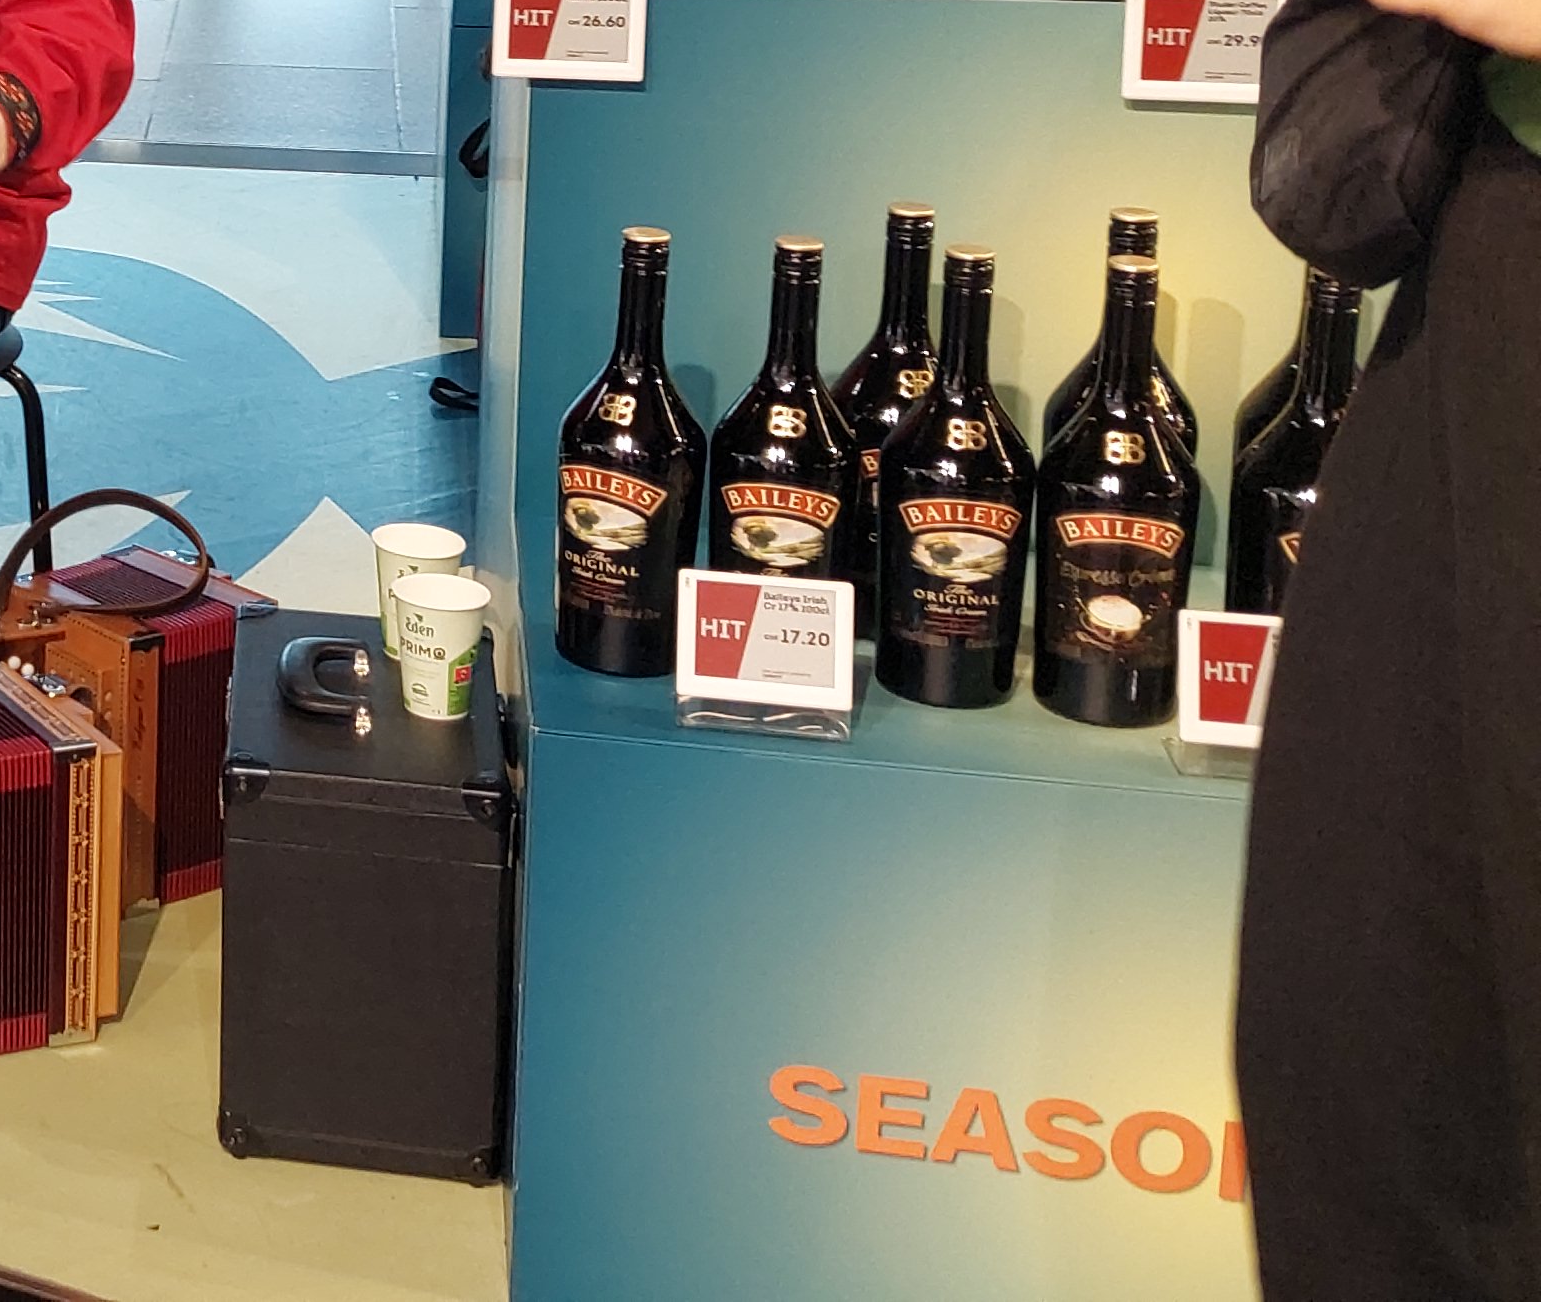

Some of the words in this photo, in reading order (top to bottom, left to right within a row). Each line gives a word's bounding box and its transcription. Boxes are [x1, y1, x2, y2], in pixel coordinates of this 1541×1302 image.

[513, 9, 554, 27] HIT
[582, 16, 625, 28] 26.60
[1147, 28, 1191, 47] HIT
[562, 470, 654, 507] BAILEYS
[729, 489, 832, 518] BAILEYS
[909, 503, 1015, 532] BAILEYS
[1067, 518, 1177, 549] BAILEYS
[564, 550, 640, 578] ORIGINAL
[763, 591, 801, 603] Baileys
[803, 595, 827, 605] Irish
[913, 588, 1000, 606] ORIGINAL
[700, 617, 746, 640] HIT
[780, 628, 830, 647] 17.20
[1204, 660, 1254, 684] HIT
